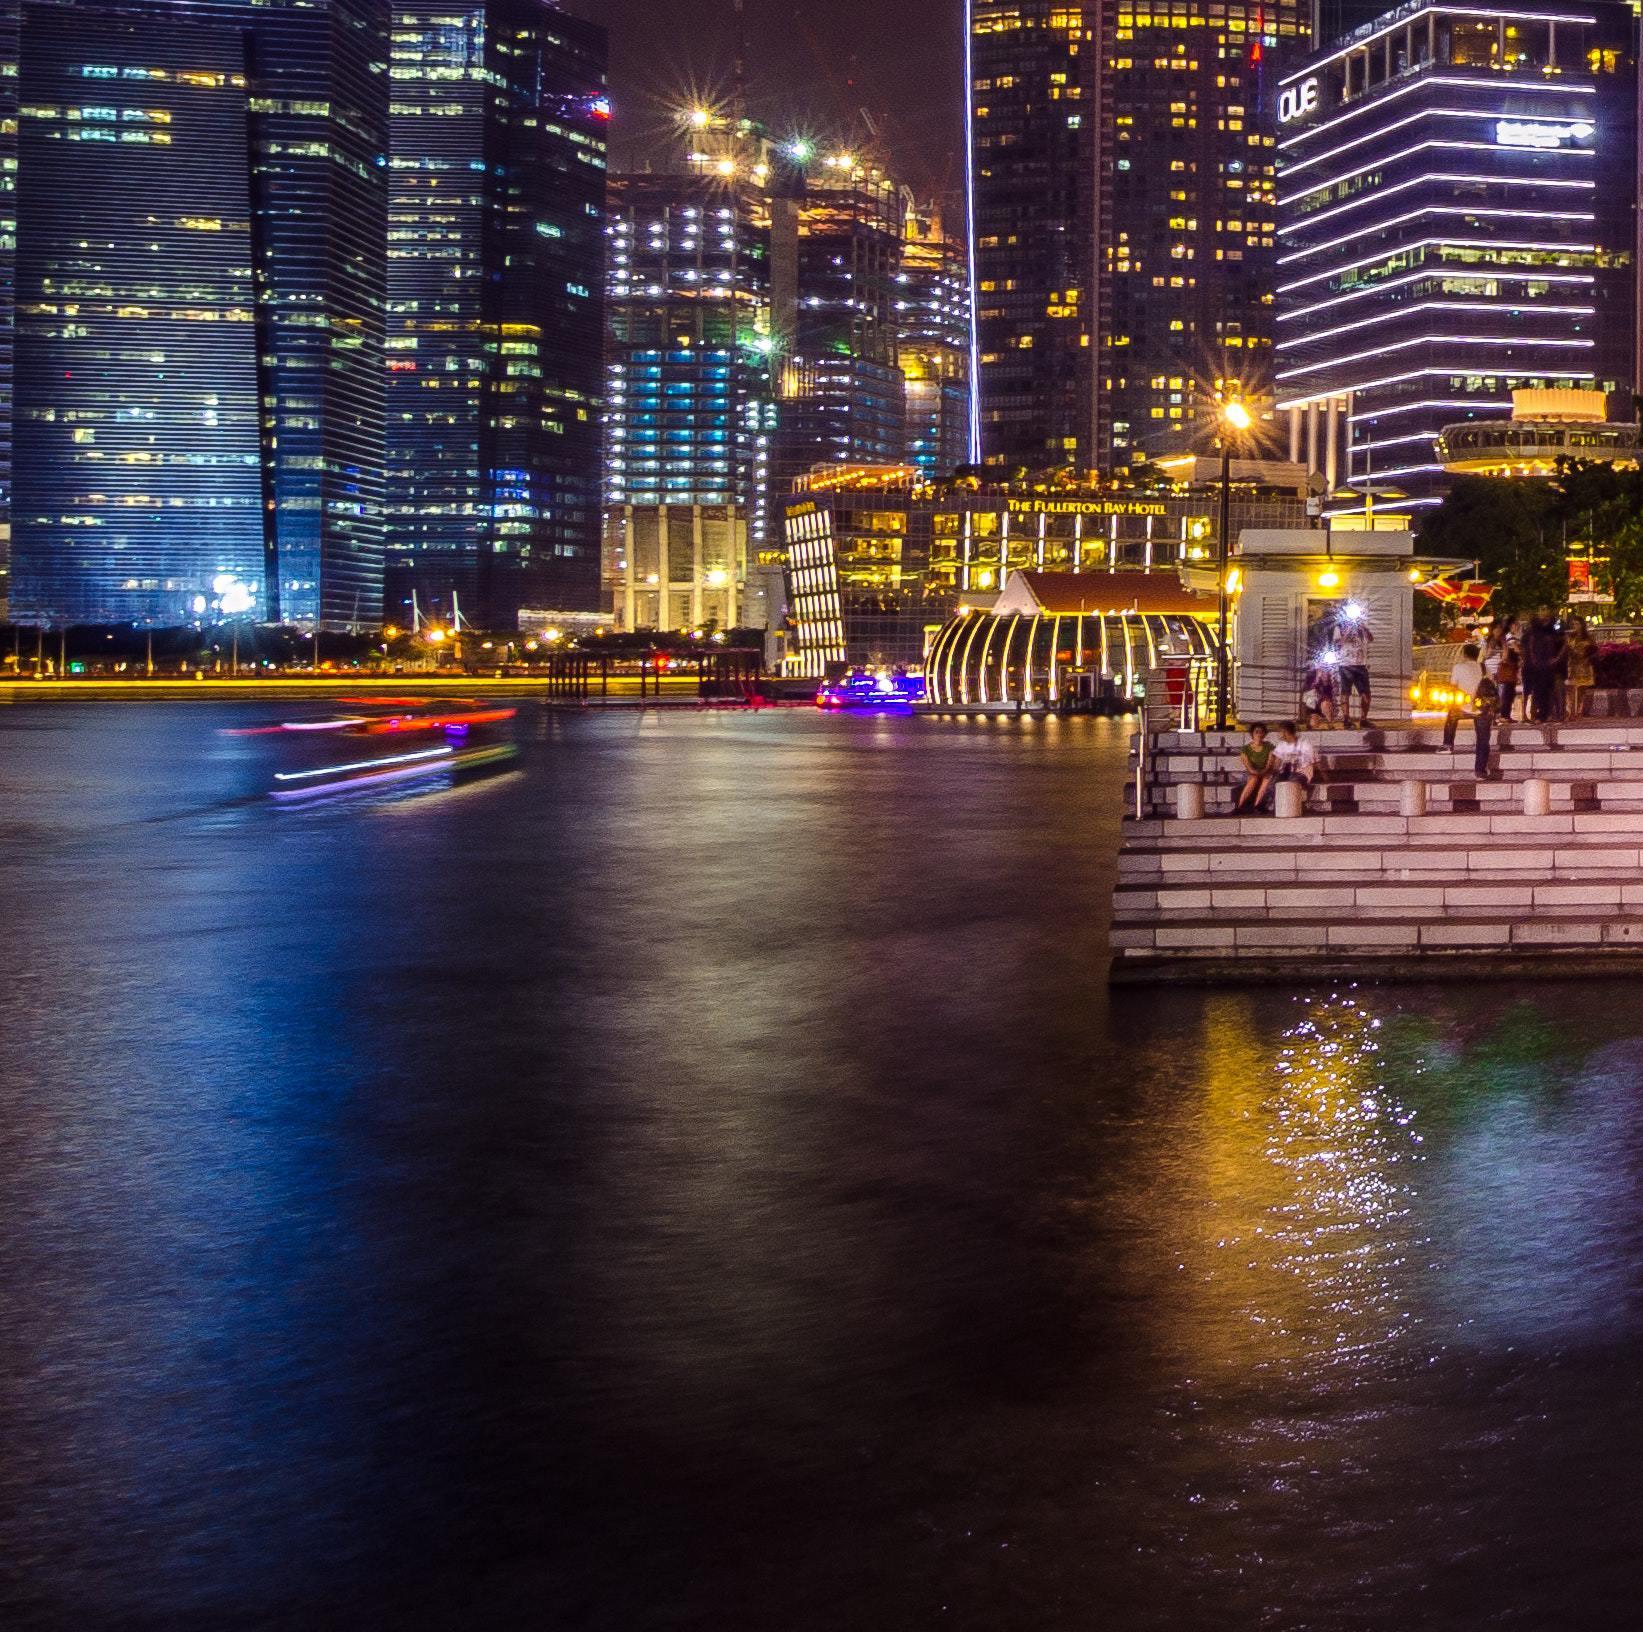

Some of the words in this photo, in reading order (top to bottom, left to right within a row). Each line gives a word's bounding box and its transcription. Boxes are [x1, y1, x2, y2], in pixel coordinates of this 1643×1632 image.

[1008, 499, 1031, 512] THE
[1034, 500, 1101, 513] FULLERTON
[1104, 502, 1126, 514] BAY
[1128, 502, 1167, 515] HOTEL
